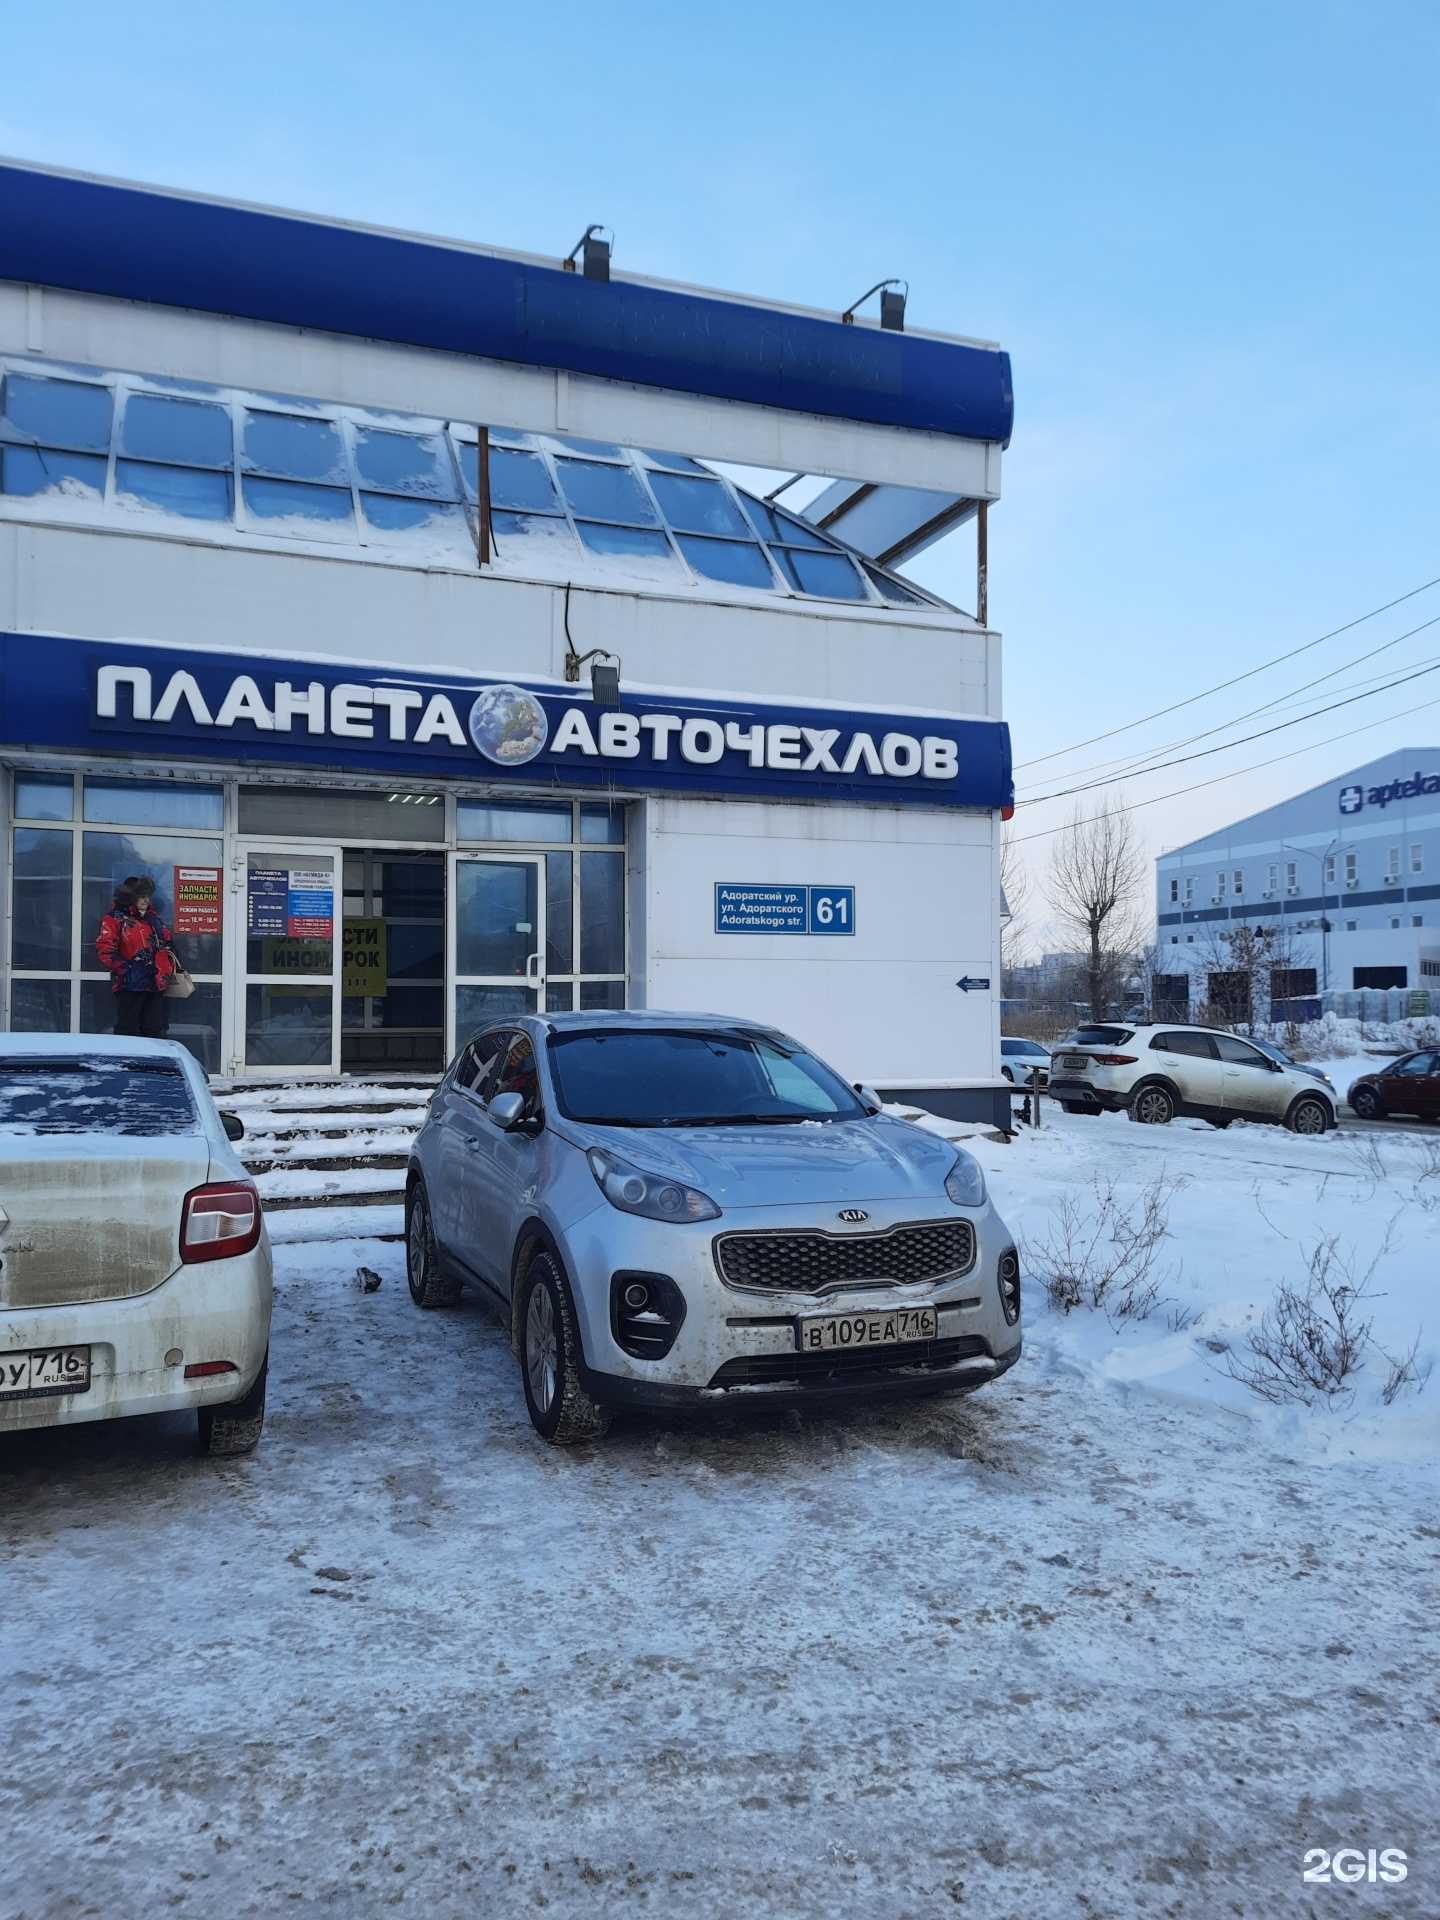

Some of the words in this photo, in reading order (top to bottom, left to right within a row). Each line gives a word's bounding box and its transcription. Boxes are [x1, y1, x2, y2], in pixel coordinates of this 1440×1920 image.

[97, 665, 468, 746] ПЛАНЕТА
[549, 708, 959, 780] АВТОЧЕХЛОВ
[179, 885, 218, 893] ЗАПЧАСТИ
[179, 893, 218, 901] ИНОМАРОК
[721, 890, 782, 901] Адоратский
[784, 894, 799, 903] ур.
[721, 904, 737, 913] ул.
[739, 903, 803, 914] Адоратского
[816, 897, 848, 924] 61
[721, 915, 785, 927] Adoratskogo
[787, 917, 802, 926] str.
[272, 950, 380, 968] ИНОМРОК
[841, 1209, 867, 1220] KIA
[900, 1311, 930, 1332] 716
[906, 1330, 921, 1338] RUS
[33, 1351, 80, 1376] 716
[44, 1374, 66, 1383] RUS
